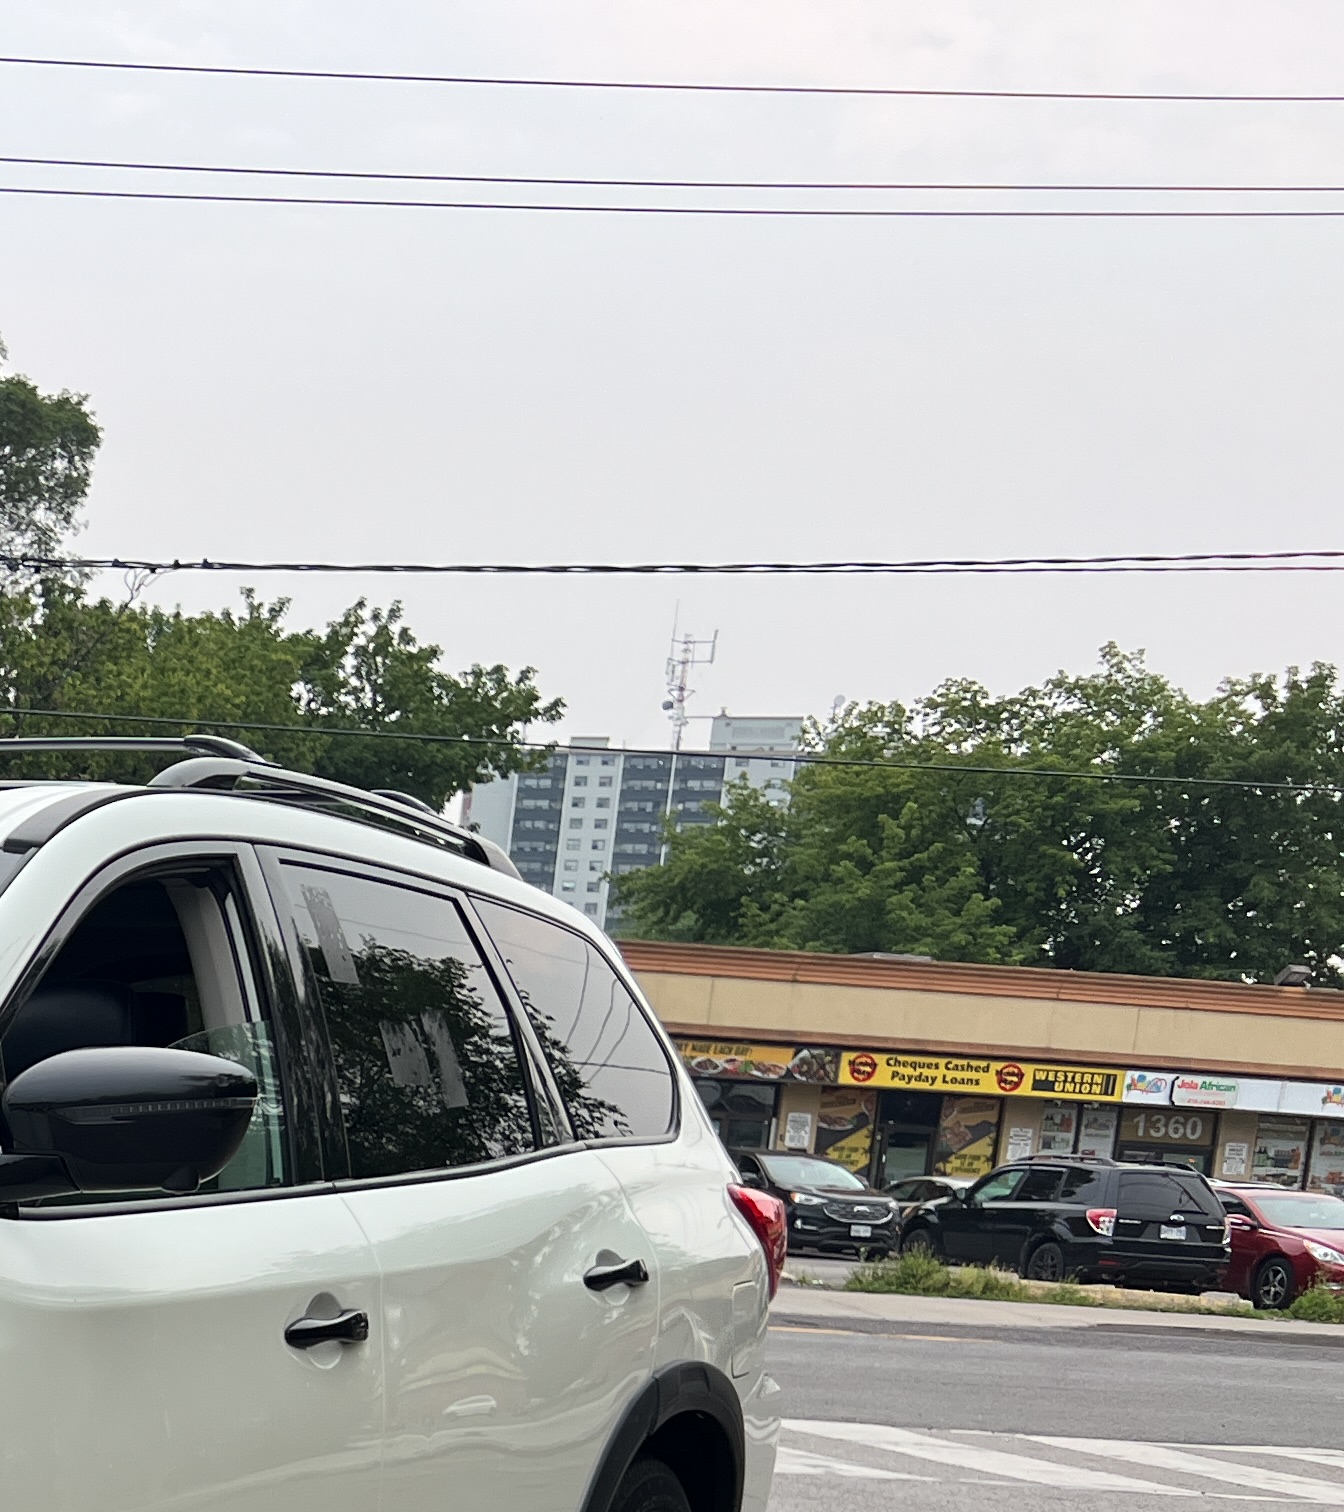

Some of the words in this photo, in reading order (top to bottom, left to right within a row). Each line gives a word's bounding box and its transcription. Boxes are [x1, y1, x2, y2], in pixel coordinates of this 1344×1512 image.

[885, 1057, 940, 1072] Cheques
[945, 1060, 991, 1074] Cashed
[890, 1070, 938, 1087] Payday
[941, 1073, 981, 1086] Loans
[1034, 1070, 1103, 1083] WESTERN
[1054, 1082, 1101, 1094] UNION
[1199, 1080, 1236, 1092] African
[1133, 1112, 1203, 1141] 1360
